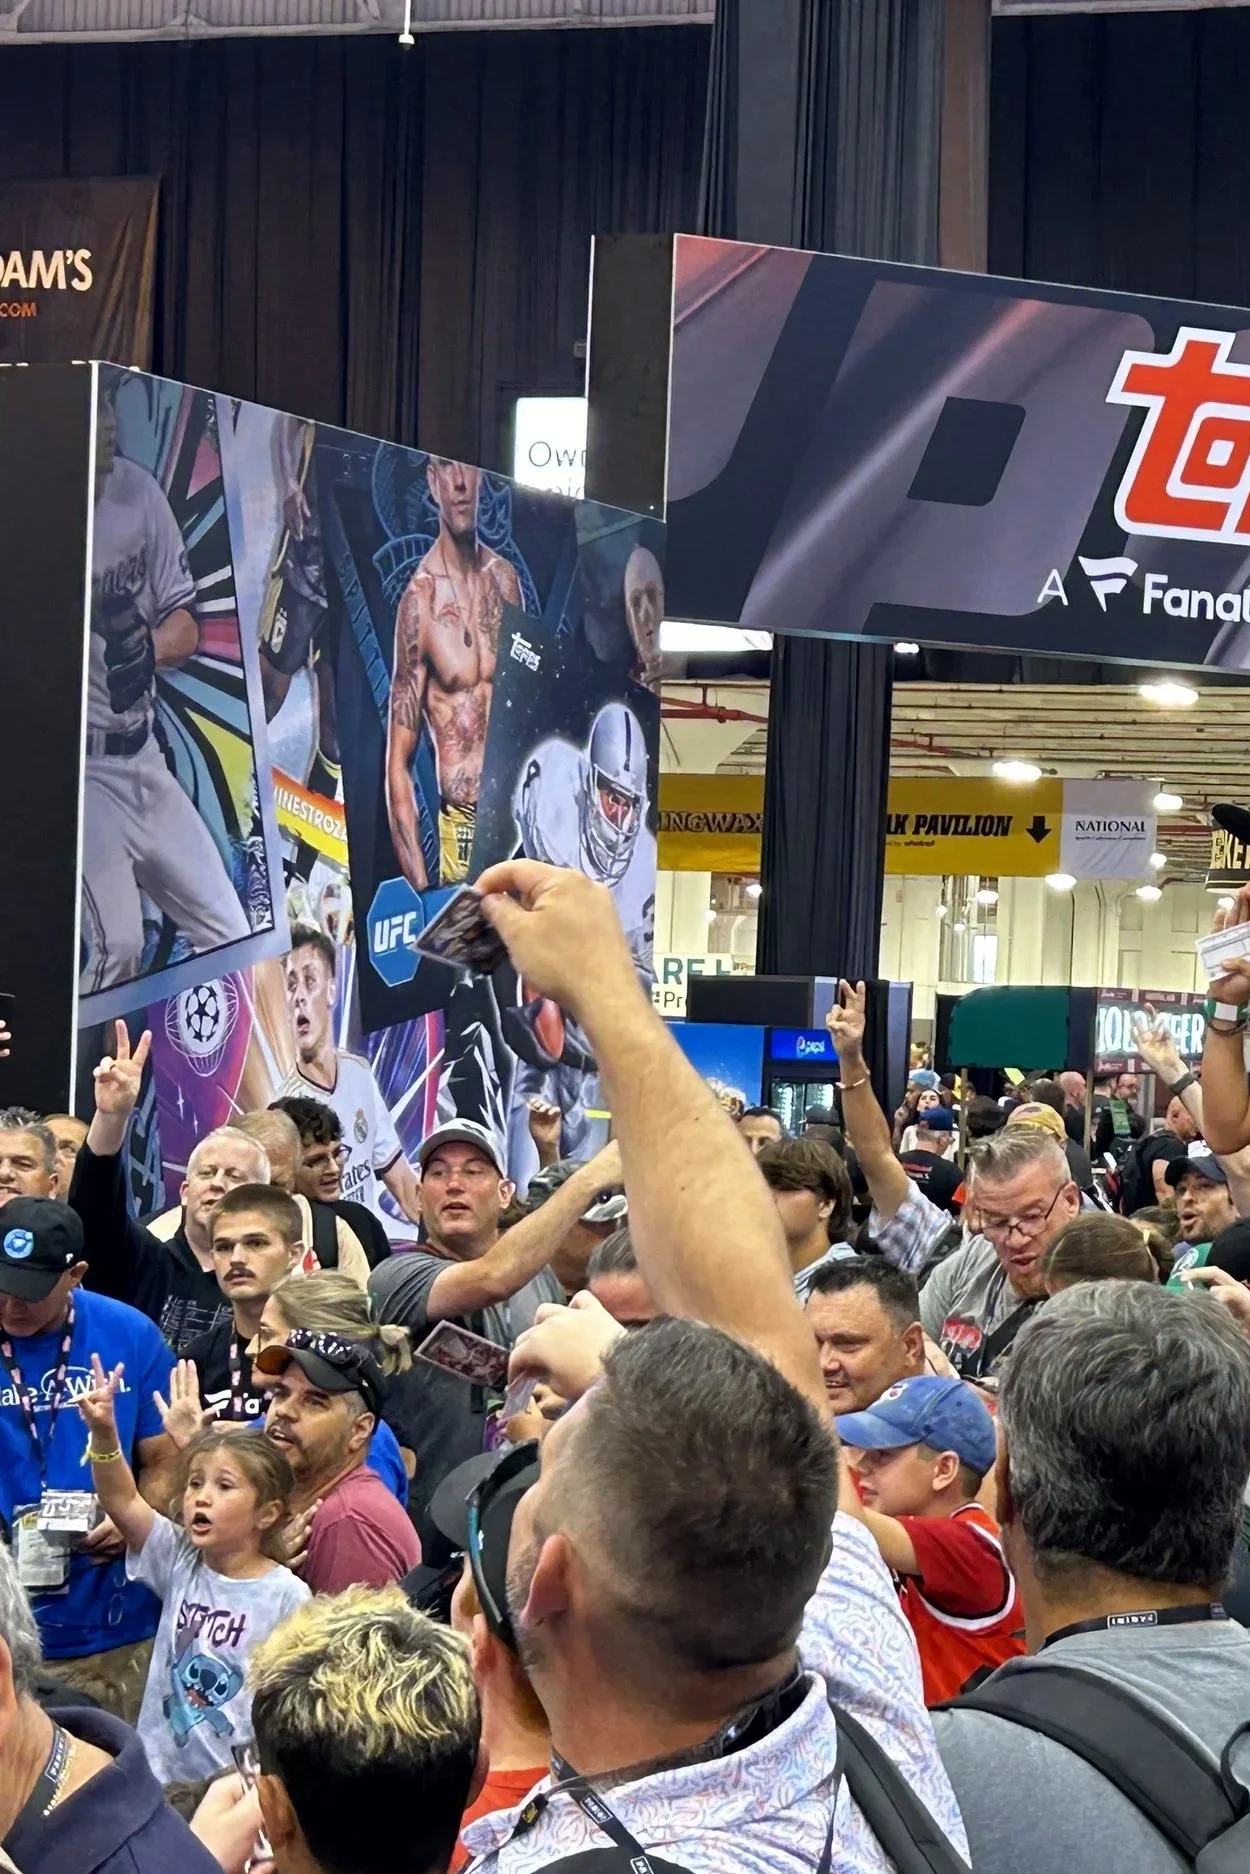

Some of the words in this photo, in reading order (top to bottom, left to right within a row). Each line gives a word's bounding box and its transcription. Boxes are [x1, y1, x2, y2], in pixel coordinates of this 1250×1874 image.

[0, 249, 93, 291] AM'S
[1037, 569, 1069, 606] A
[912, 814, 1013, 837] PAVILION
[374, 911, 417, 953] UFC
